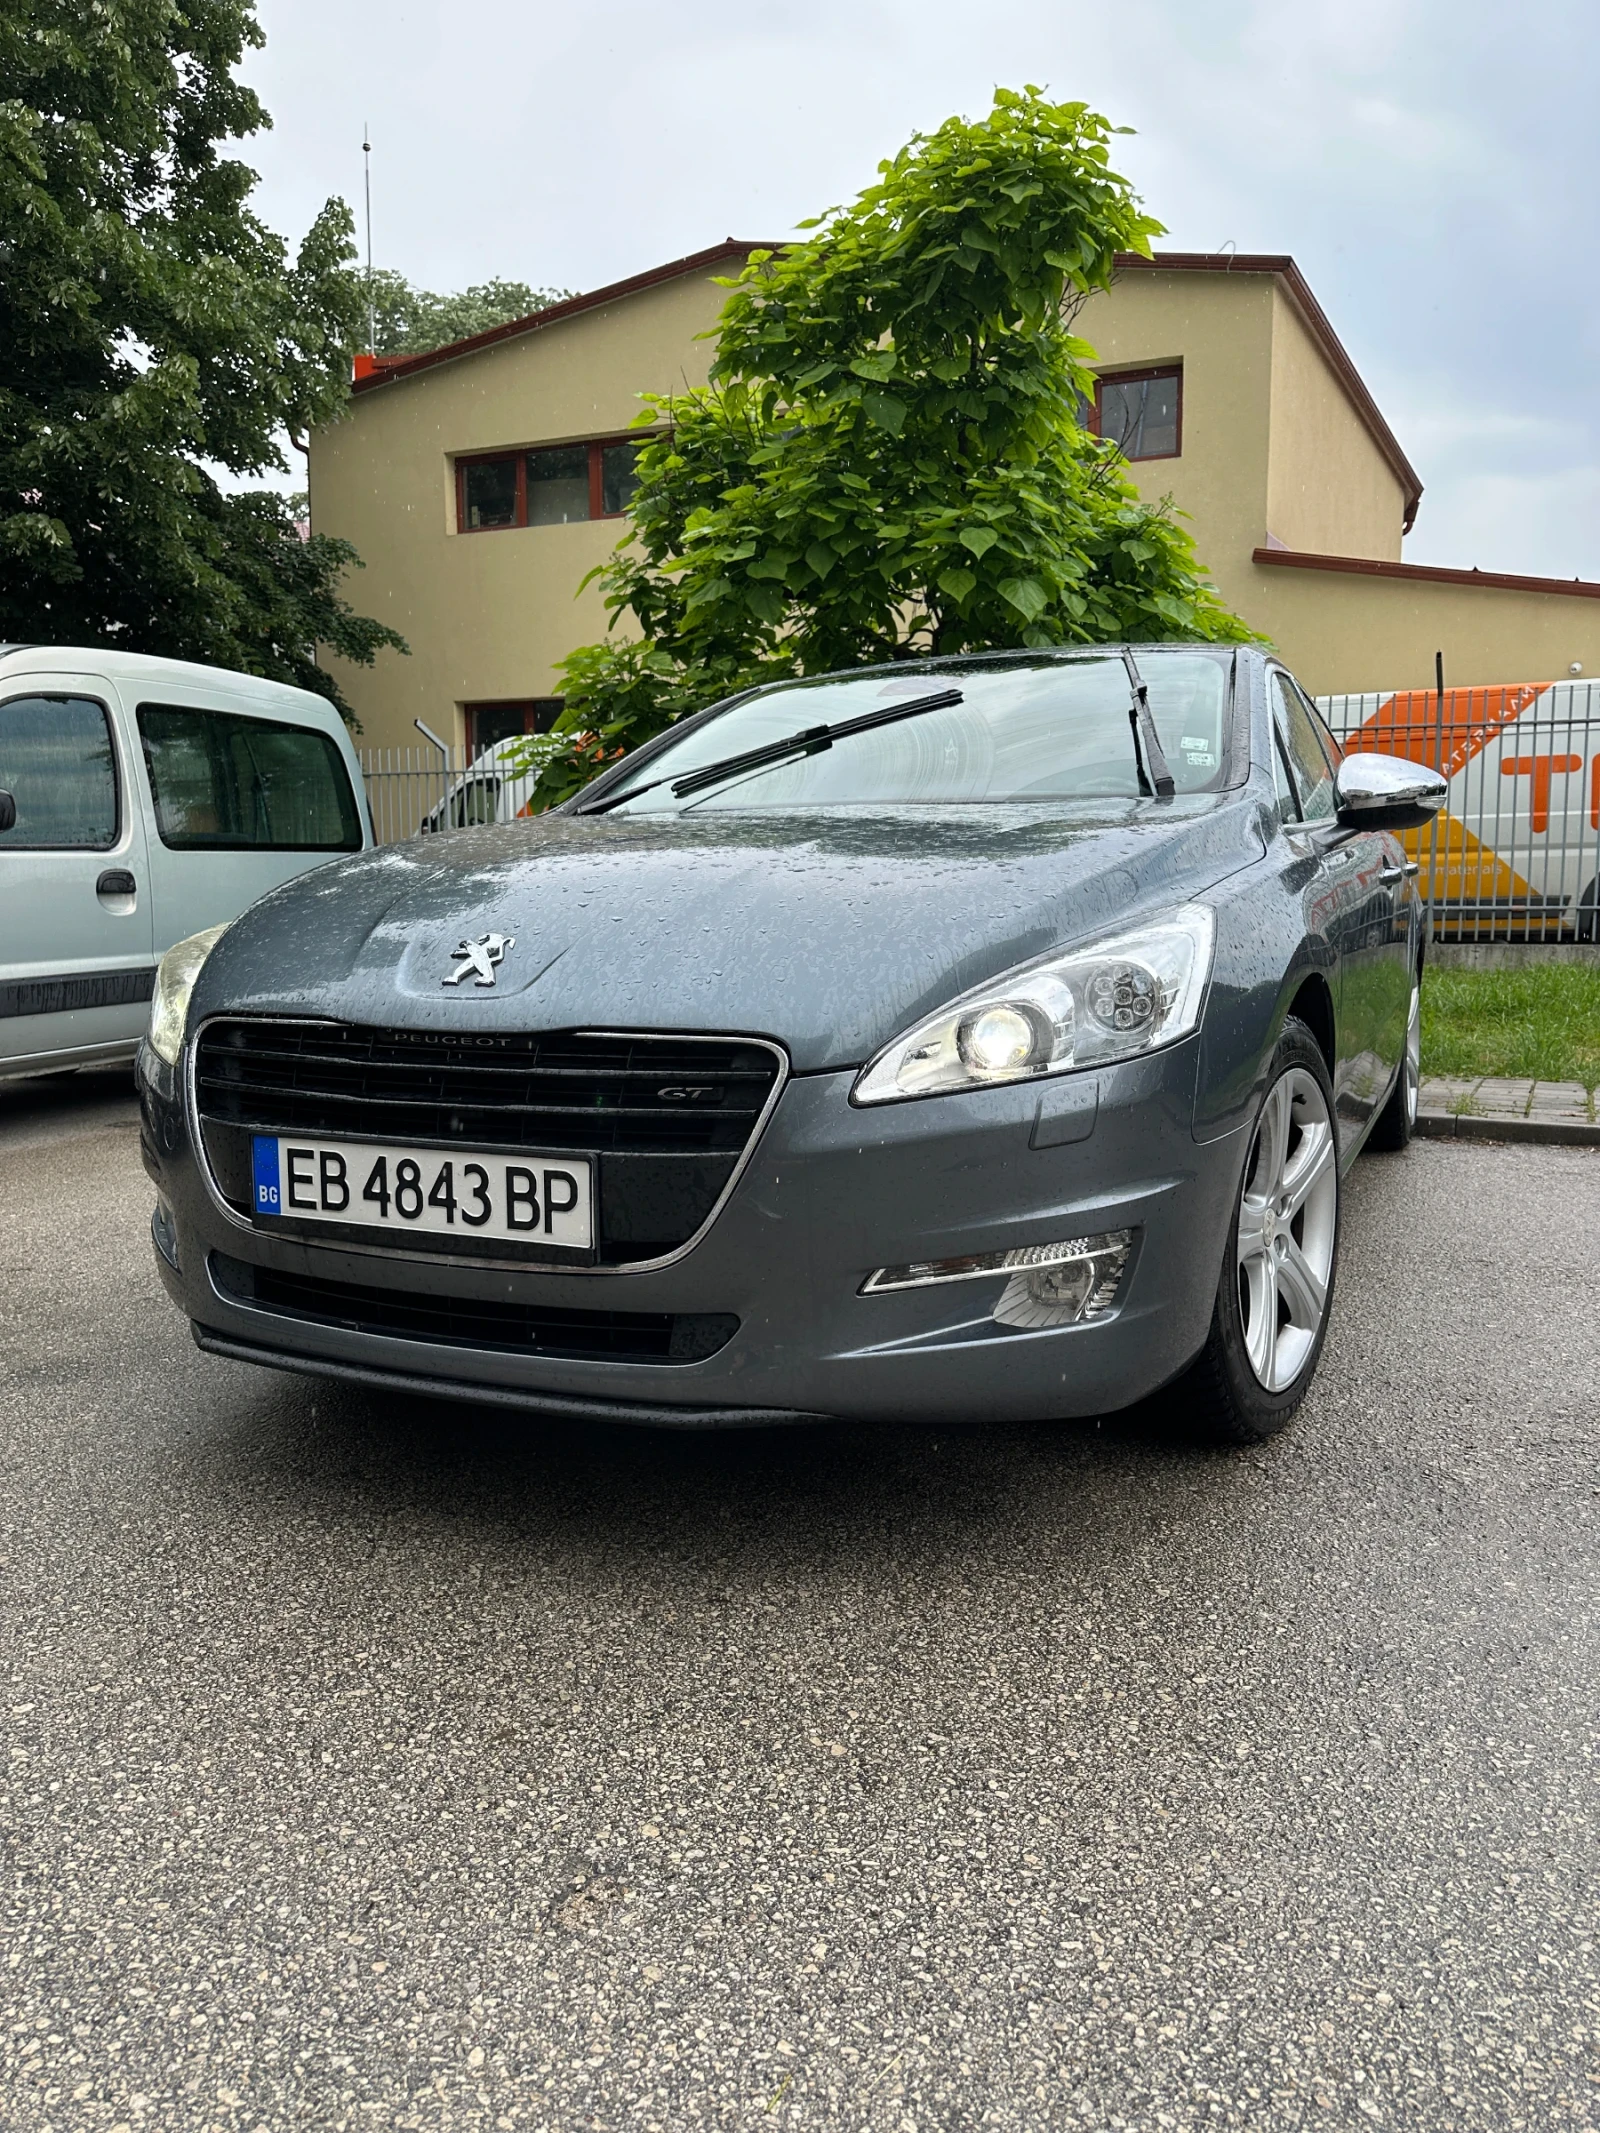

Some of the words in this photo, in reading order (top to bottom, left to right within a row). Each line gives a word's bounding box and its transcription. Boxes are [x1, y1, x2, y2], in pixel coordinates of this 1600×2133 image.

[394, 1033, 511, 1047] PEUGEOT
[657, 1087, 713, 1100] GT
[258, 1185, 278, 1204] BG
[287, 1148, 350, 1212] EB
[362, 1156, 492, 1227] 4843
[506, 1166, 578, 1234] BP
